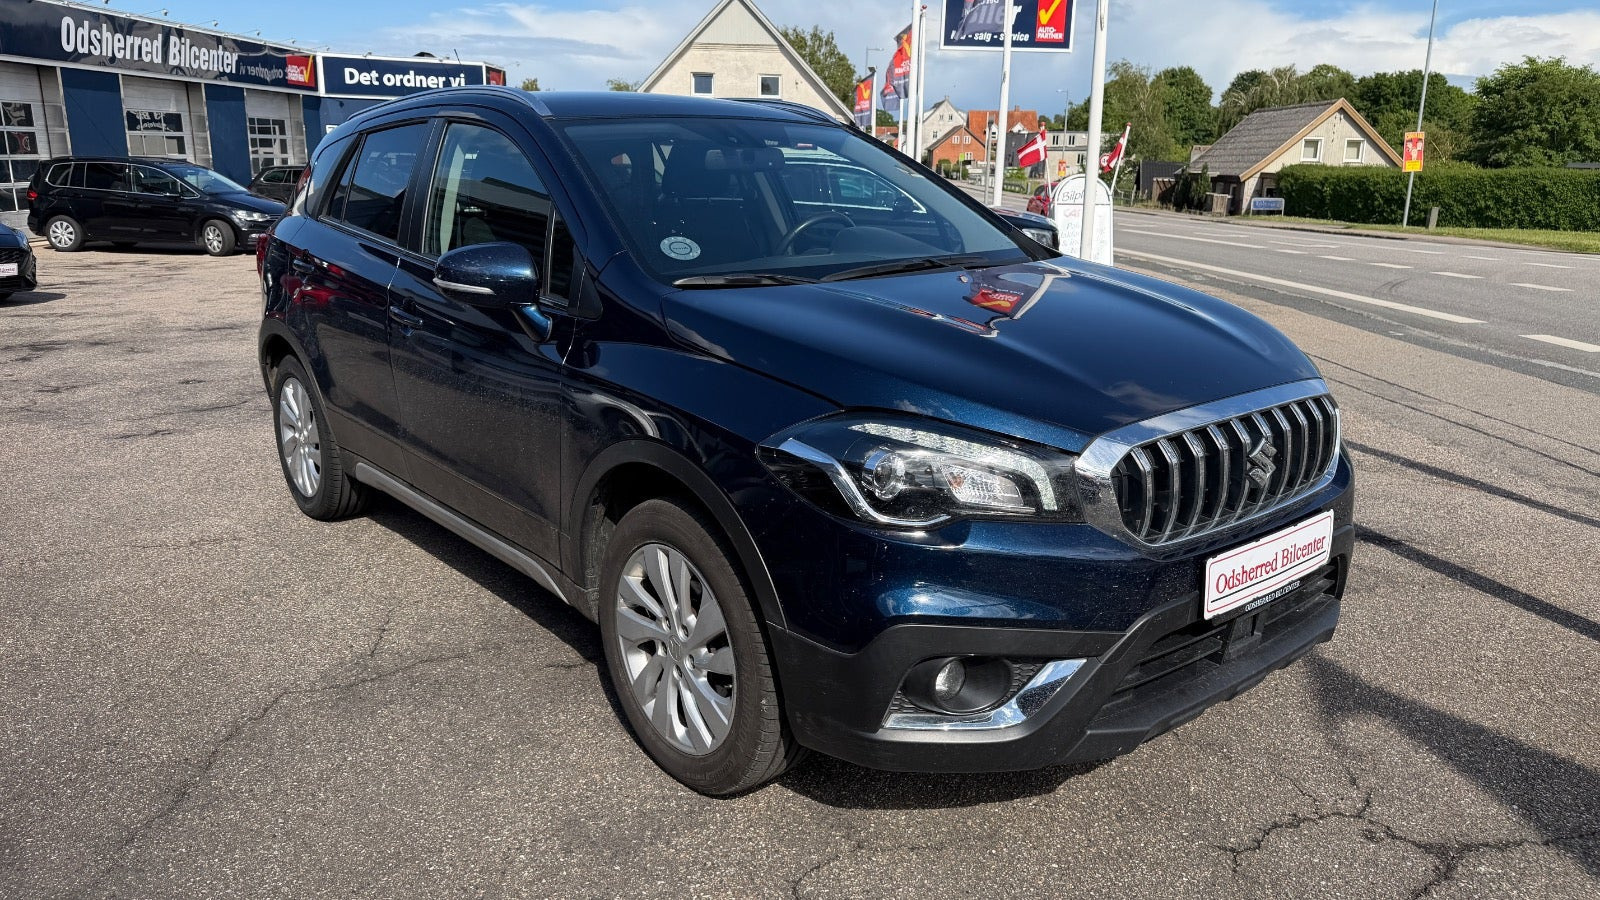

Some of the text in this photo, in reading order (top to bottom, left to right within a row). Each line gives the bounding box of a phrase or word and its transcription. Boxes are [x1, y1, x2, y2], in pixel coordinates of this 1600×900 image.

[61, 16, 238, 74] Odsherred Bilcenter
[974, 32, 992, 42] salg
[999, 32, 1030, 42] svice
[1037, 32, 1063, 40] PARTNER
[344, 67, 466, 88] Det ordner vi
[1216, 536, 1326, 594] Odsherred Bilcenter
[1245, 580, 1301, 612] ODSHERRED BILCENTER
